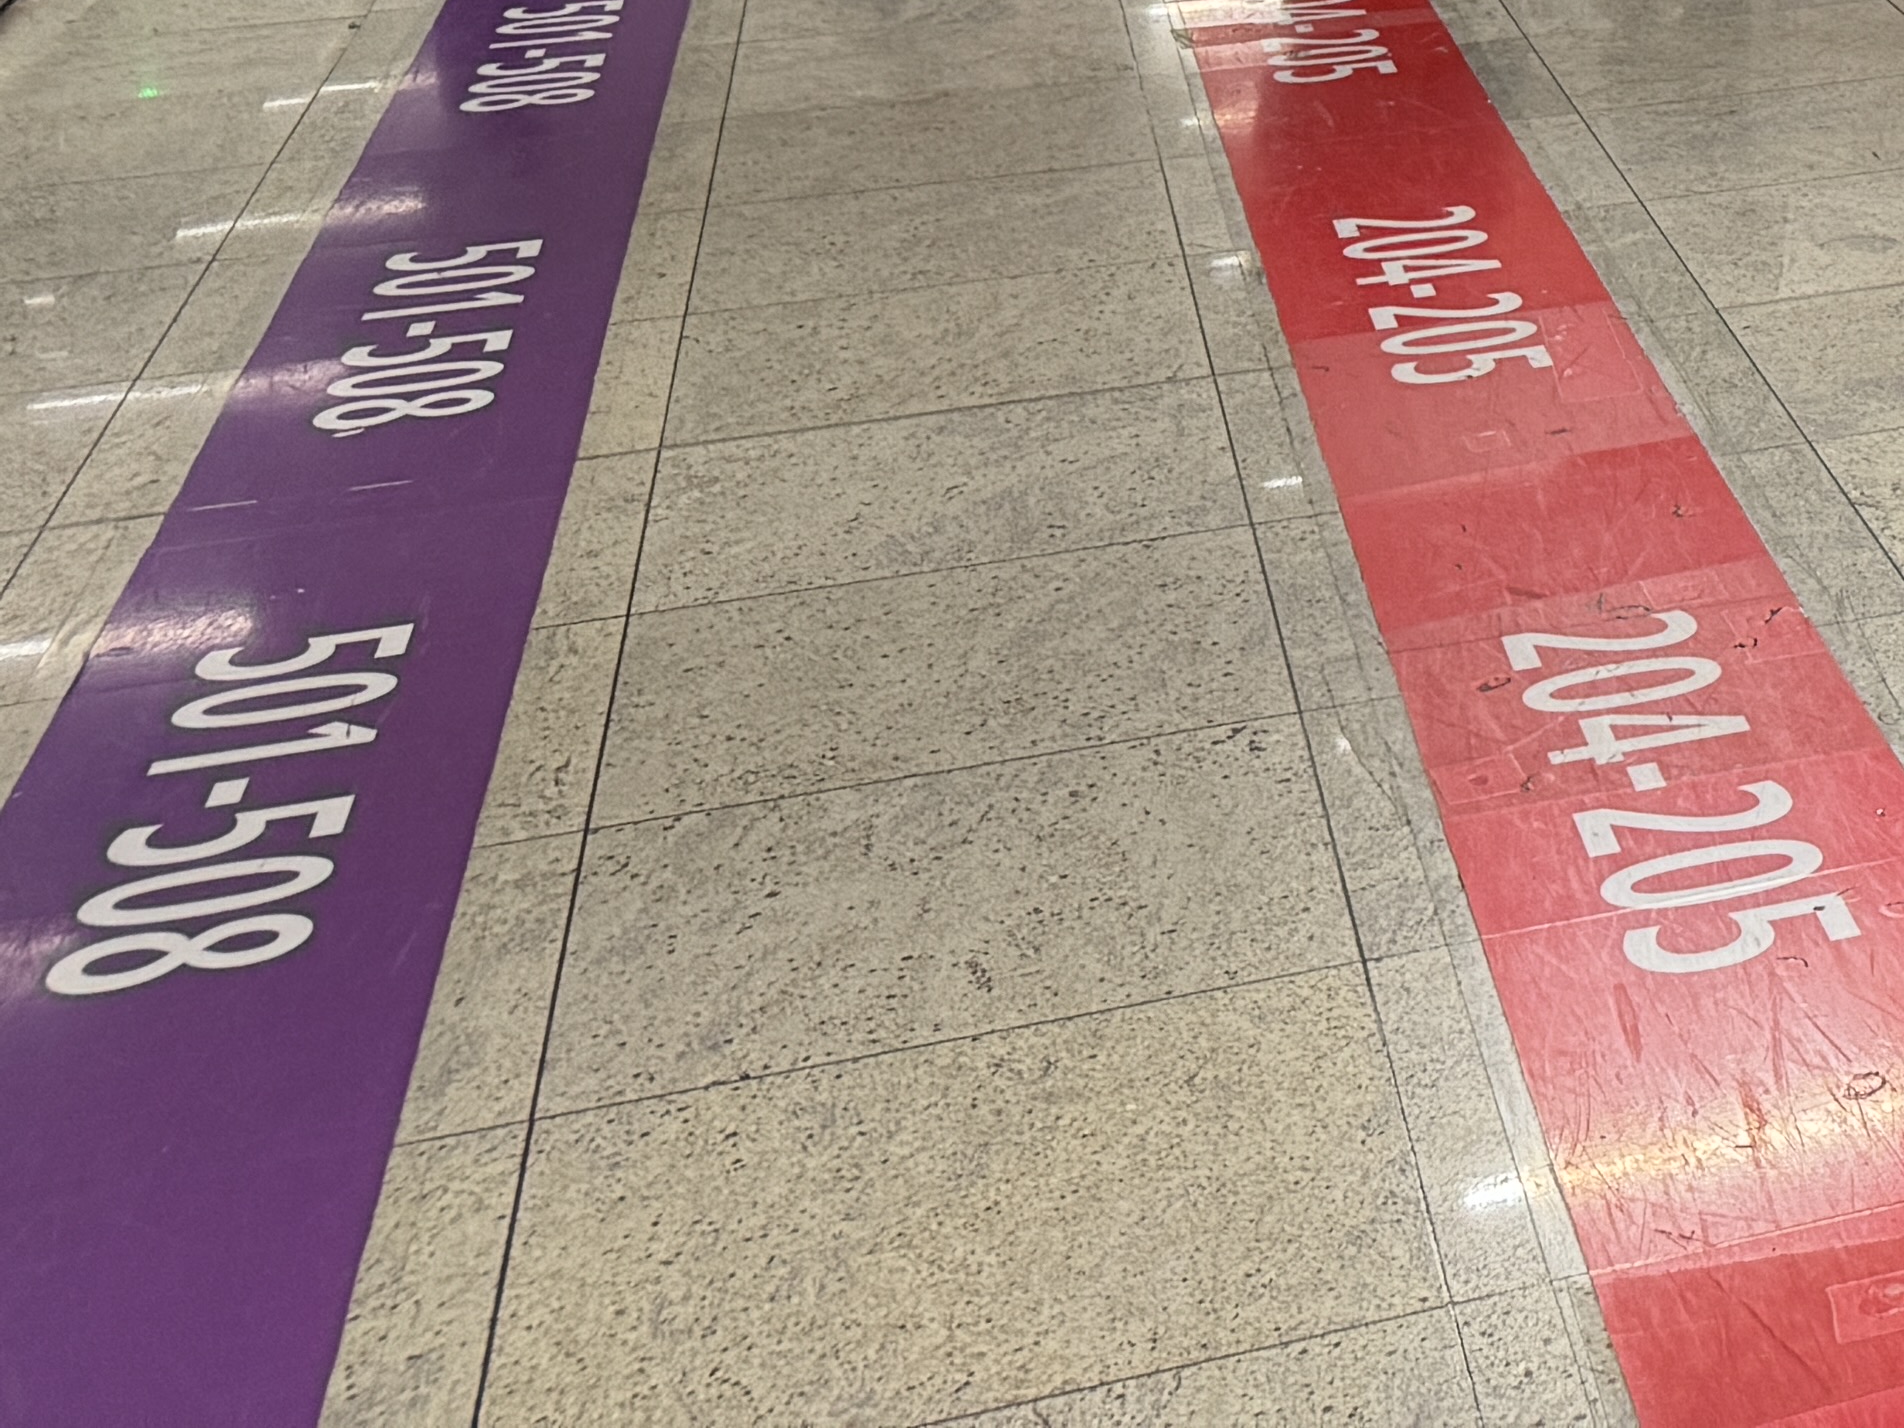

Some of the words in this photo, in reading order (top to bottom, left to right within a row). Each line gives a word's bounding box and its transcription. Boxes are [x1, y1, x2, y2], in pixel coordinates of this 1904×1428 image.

[311, 237, 544, 432] 501-508
[1331, 205, 1553, 386] 204-205
[45, 622, 416, 997] 501-508
[1500, 608, 1863, 975] 204-205
